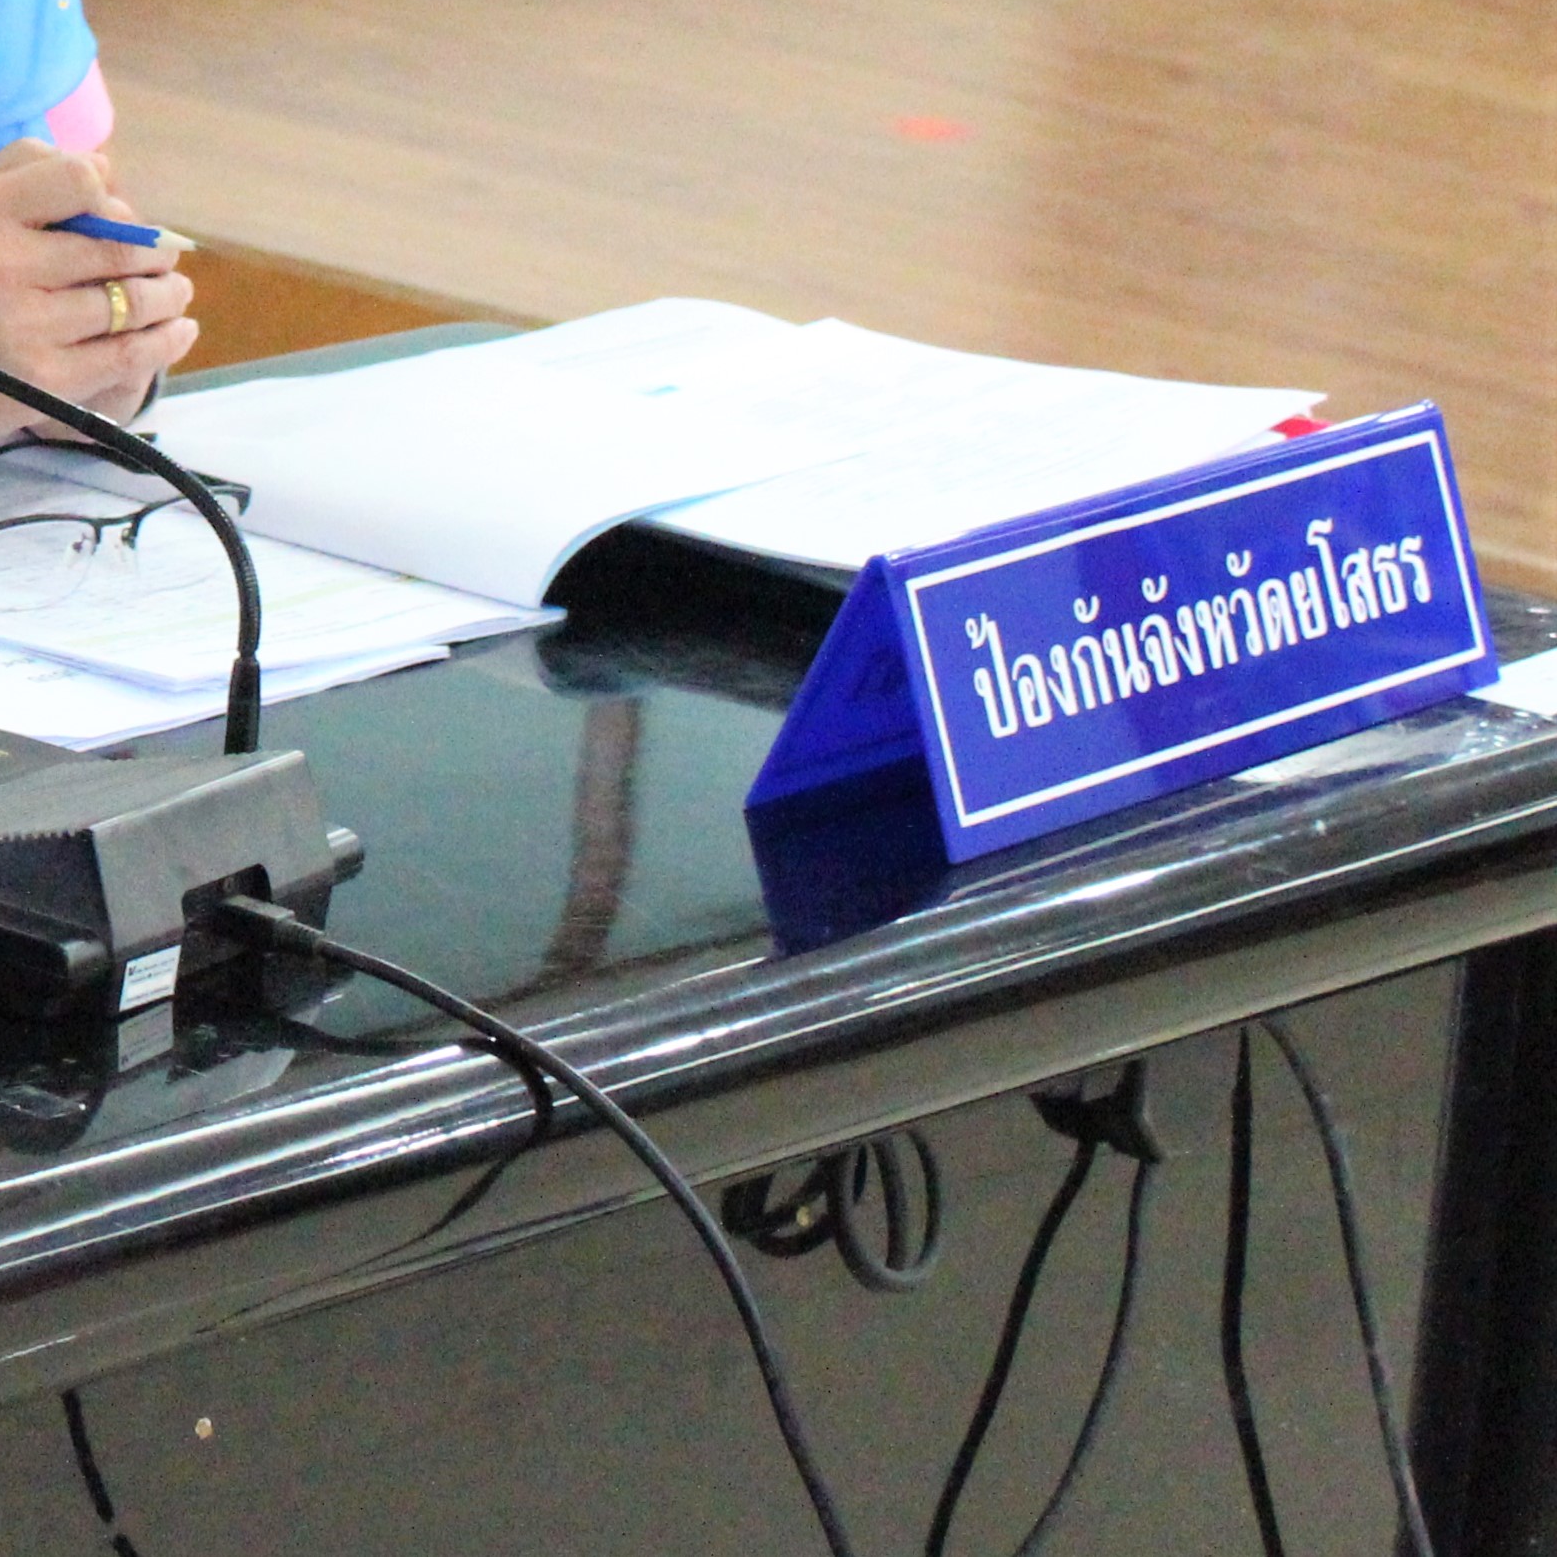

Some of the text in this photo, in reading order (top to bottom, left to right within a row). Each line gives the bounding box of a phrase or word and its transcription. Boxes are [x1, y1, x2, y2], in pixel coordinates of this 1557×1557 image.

[964, 518, 1433, 739] ป้องกันจังหวัดยโสธร
